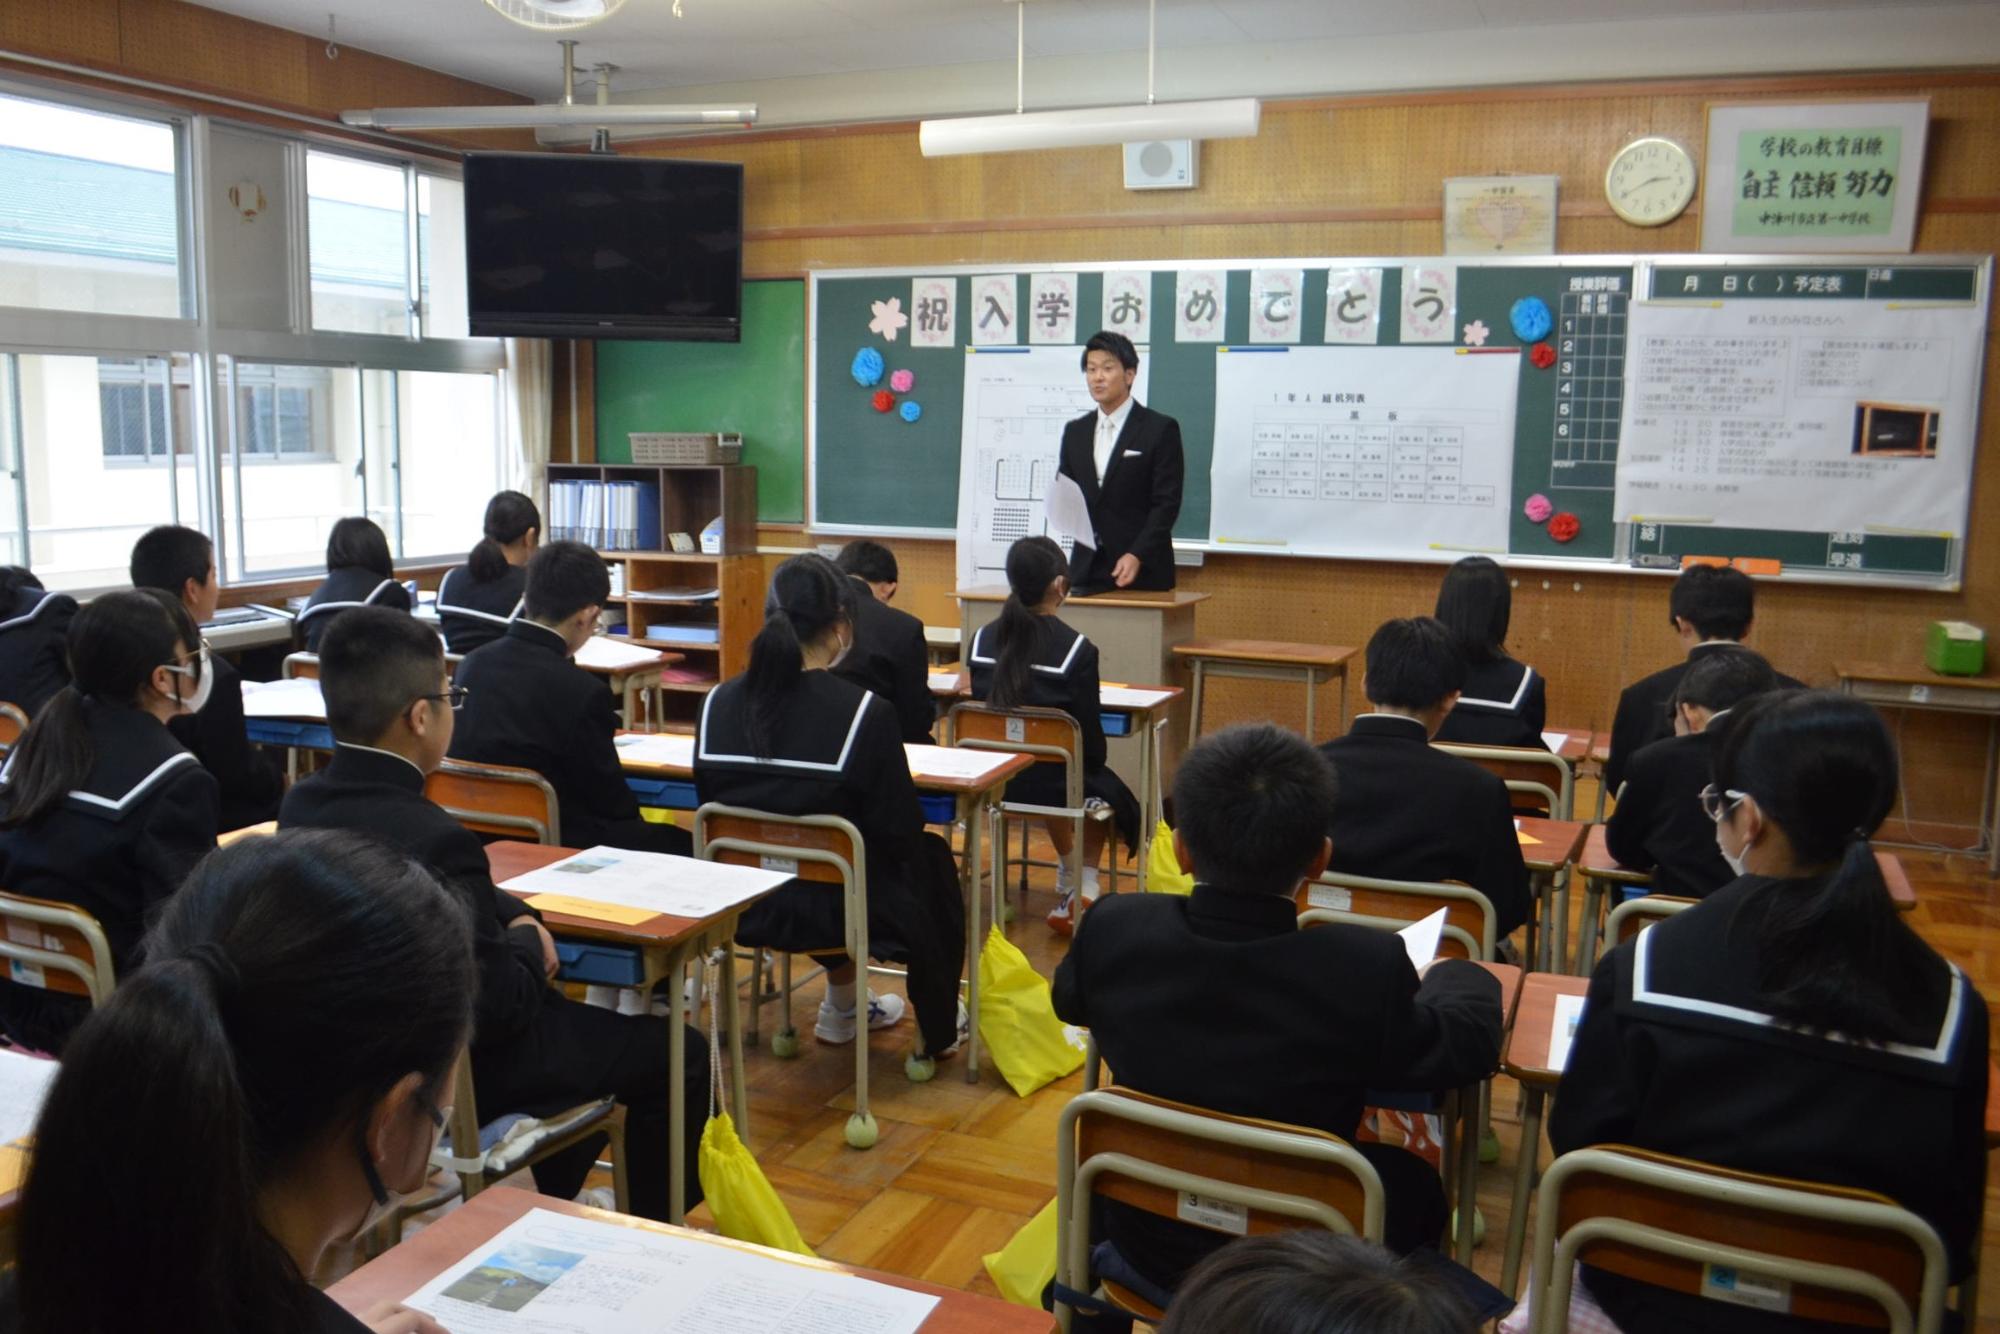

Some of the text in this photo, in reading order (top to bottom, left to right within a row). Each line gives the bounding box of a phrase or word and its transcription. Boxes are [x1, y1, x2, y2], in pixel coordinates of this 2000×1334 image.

[1759, 136, 1884, 158] 学校の教育目標
[1741, 169, 1894, 200] 自主 信頼 努力
[1683, 276, 1698, 291] 月
[1565, 320, 1572, 331] 1
[1563, 341, 1573, 352] 2
[1562, 362, 1572, 373] 3
[1560, 383, 1571, 394] 4
[1560, 404, 1569, 415] 5
[1558, 424, 1569, 436] 6
[1188, 1193, 1198, 1207] 3
